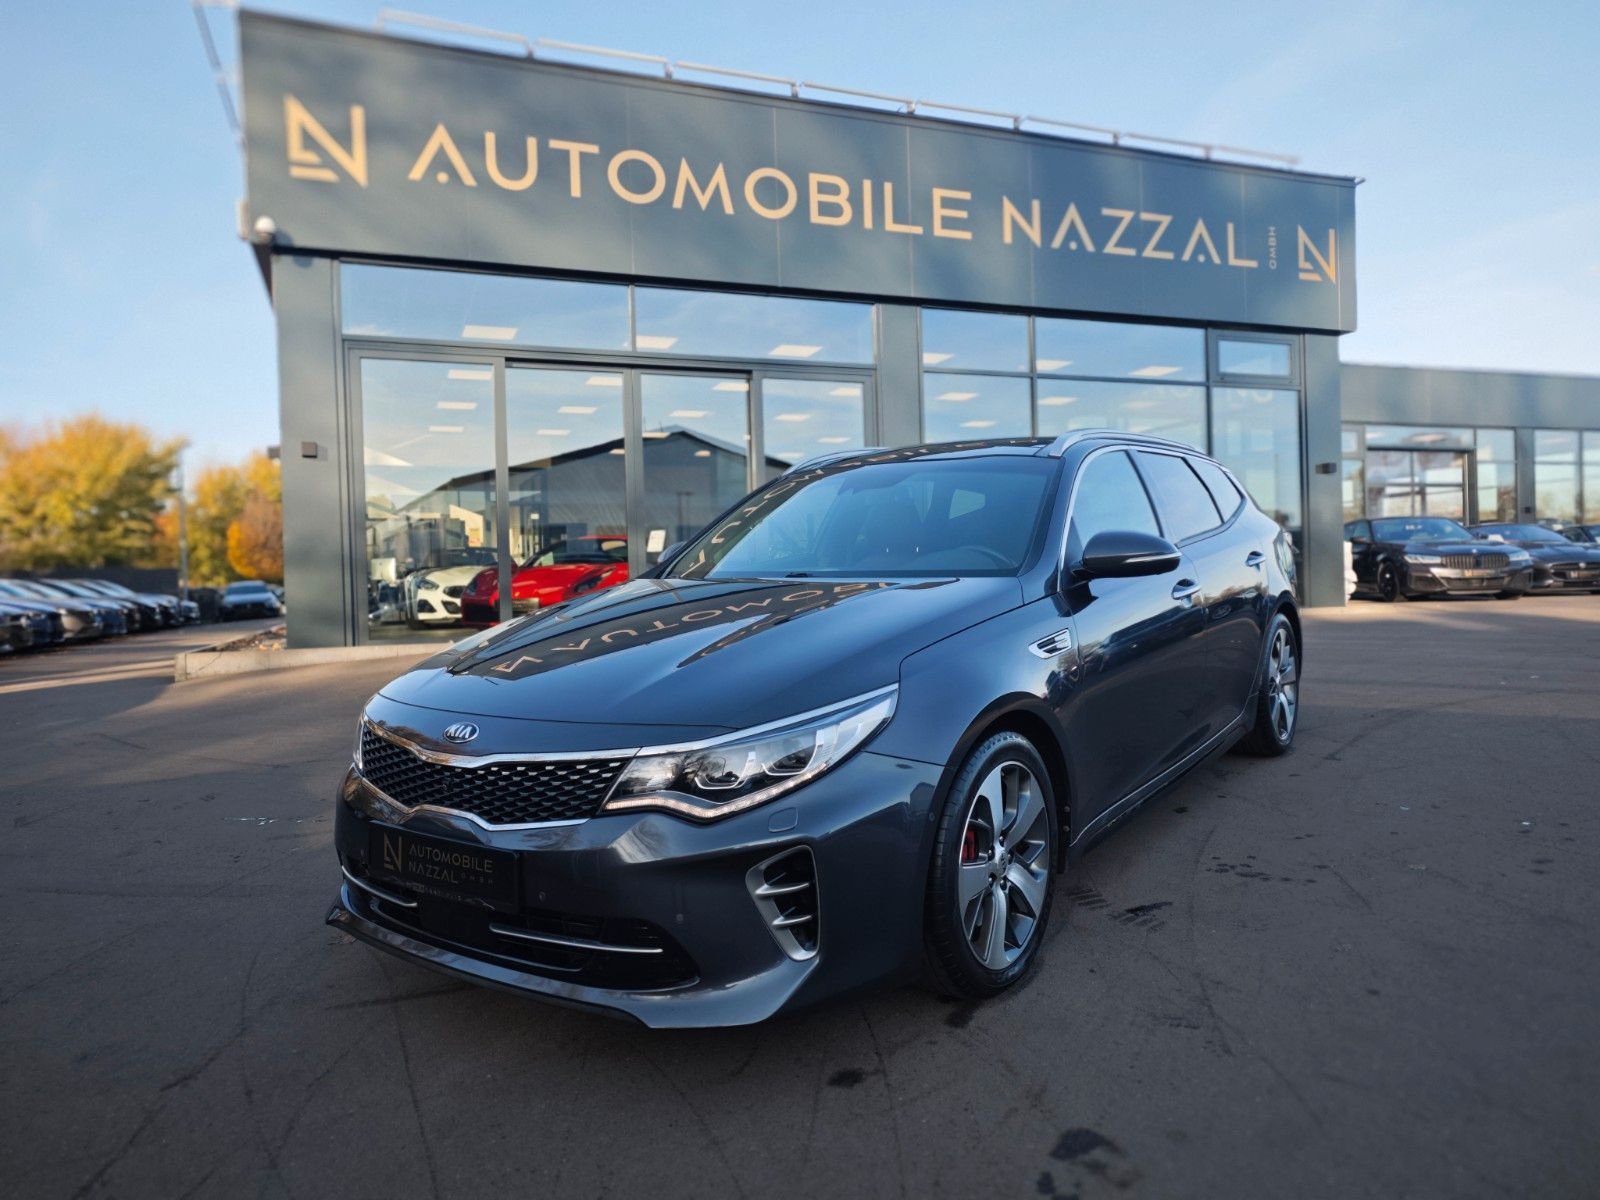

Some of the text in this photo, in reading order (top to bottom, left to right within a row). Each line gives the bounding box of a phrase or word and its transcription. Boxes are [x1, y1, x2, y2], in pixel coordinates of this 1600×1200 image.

[406, 121, 974, 241] AUTOMOBILE
[1001, 194, 1259, 269] NAZZAL
[408, 843, 494, 874] AUTOMOBILE
[408, 861, 459, 885] NAZZAL
